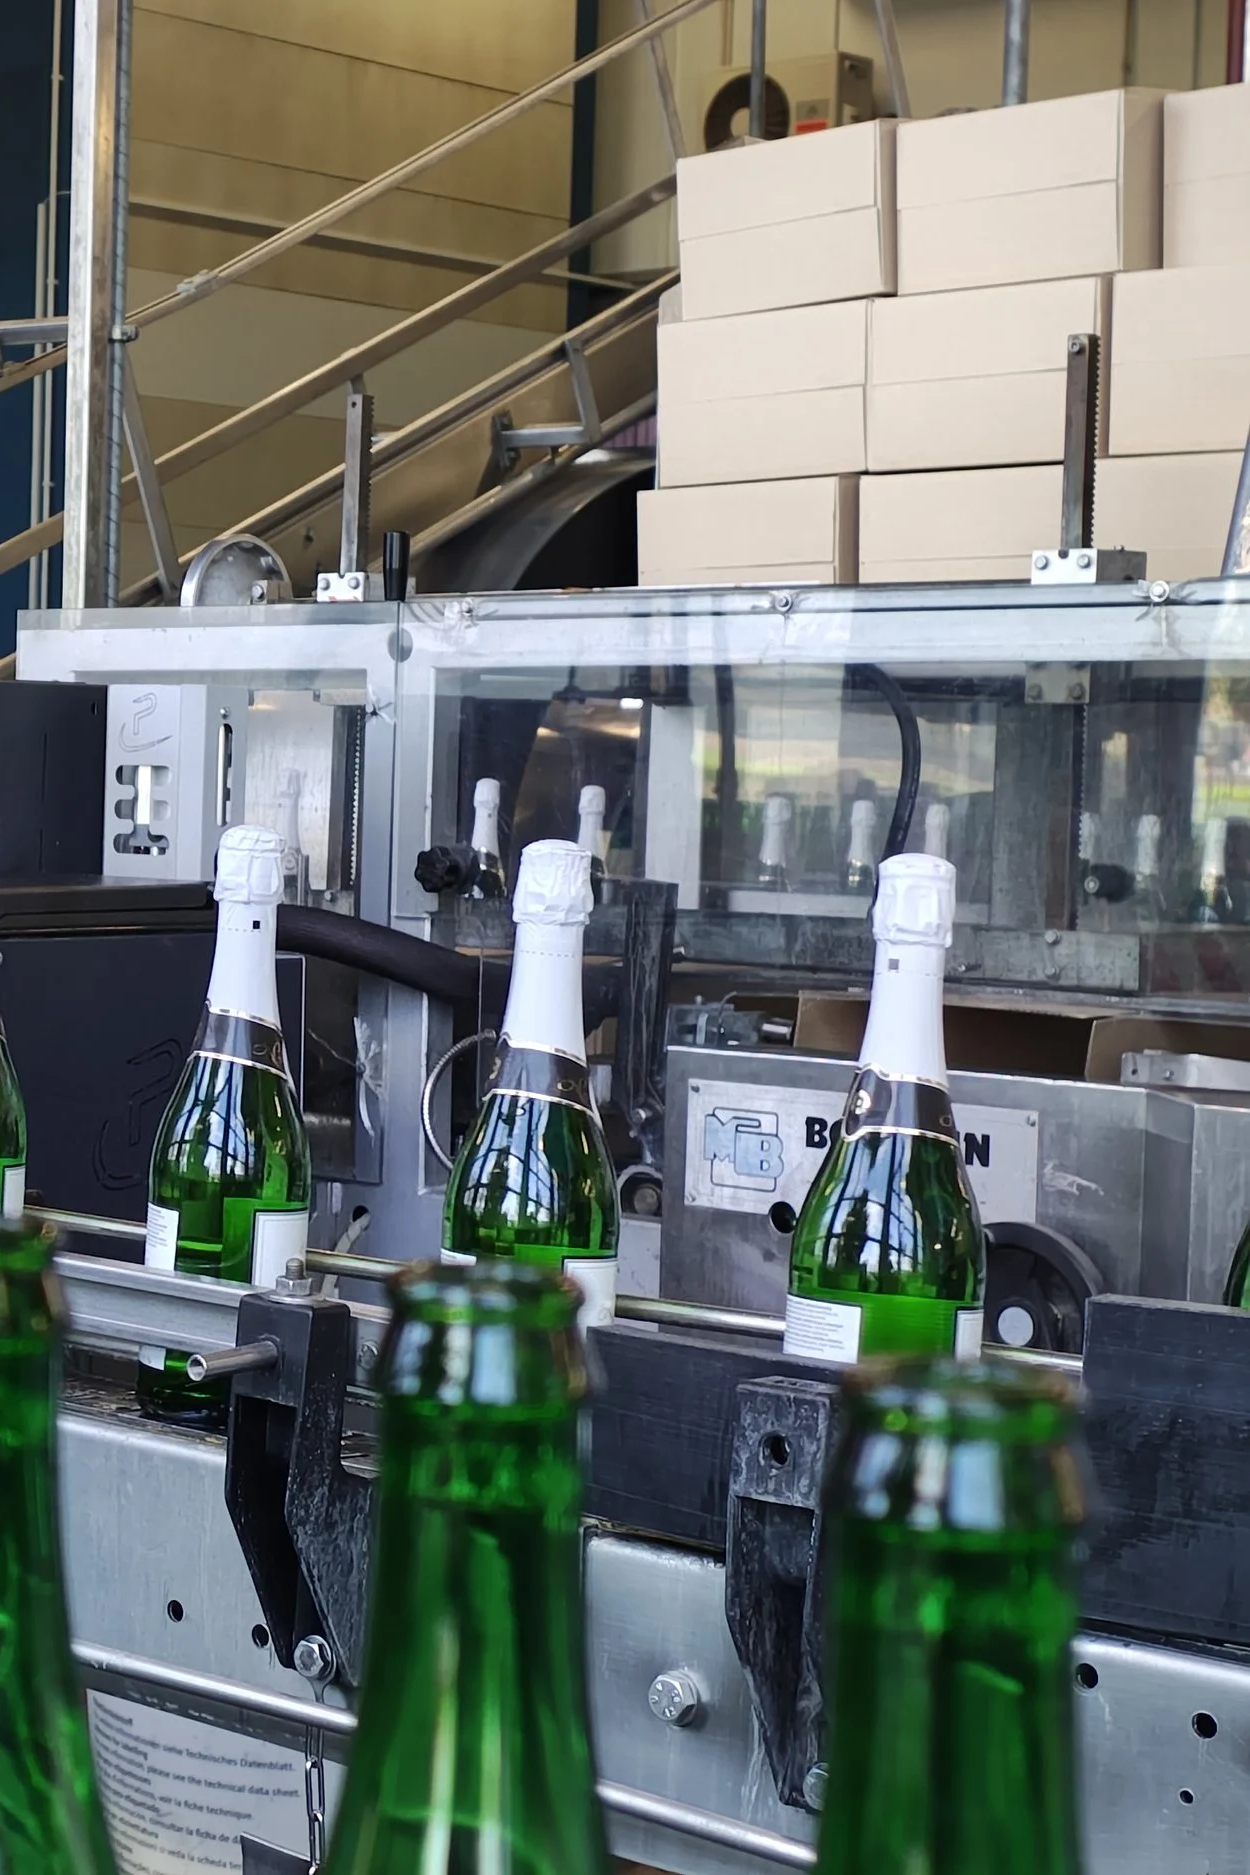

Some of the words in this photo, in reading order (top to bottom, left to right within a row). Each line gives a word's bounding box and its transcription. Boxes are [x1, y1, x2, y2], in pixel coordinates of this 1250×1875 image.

[187, 1774, 202, 1787] the
[204, 1779, 246, 1794] technical
[248, 1785, 269, 1796] data
[184, 1799, 204, 1813] fiche
[218, 1833, 230, 1843] de
